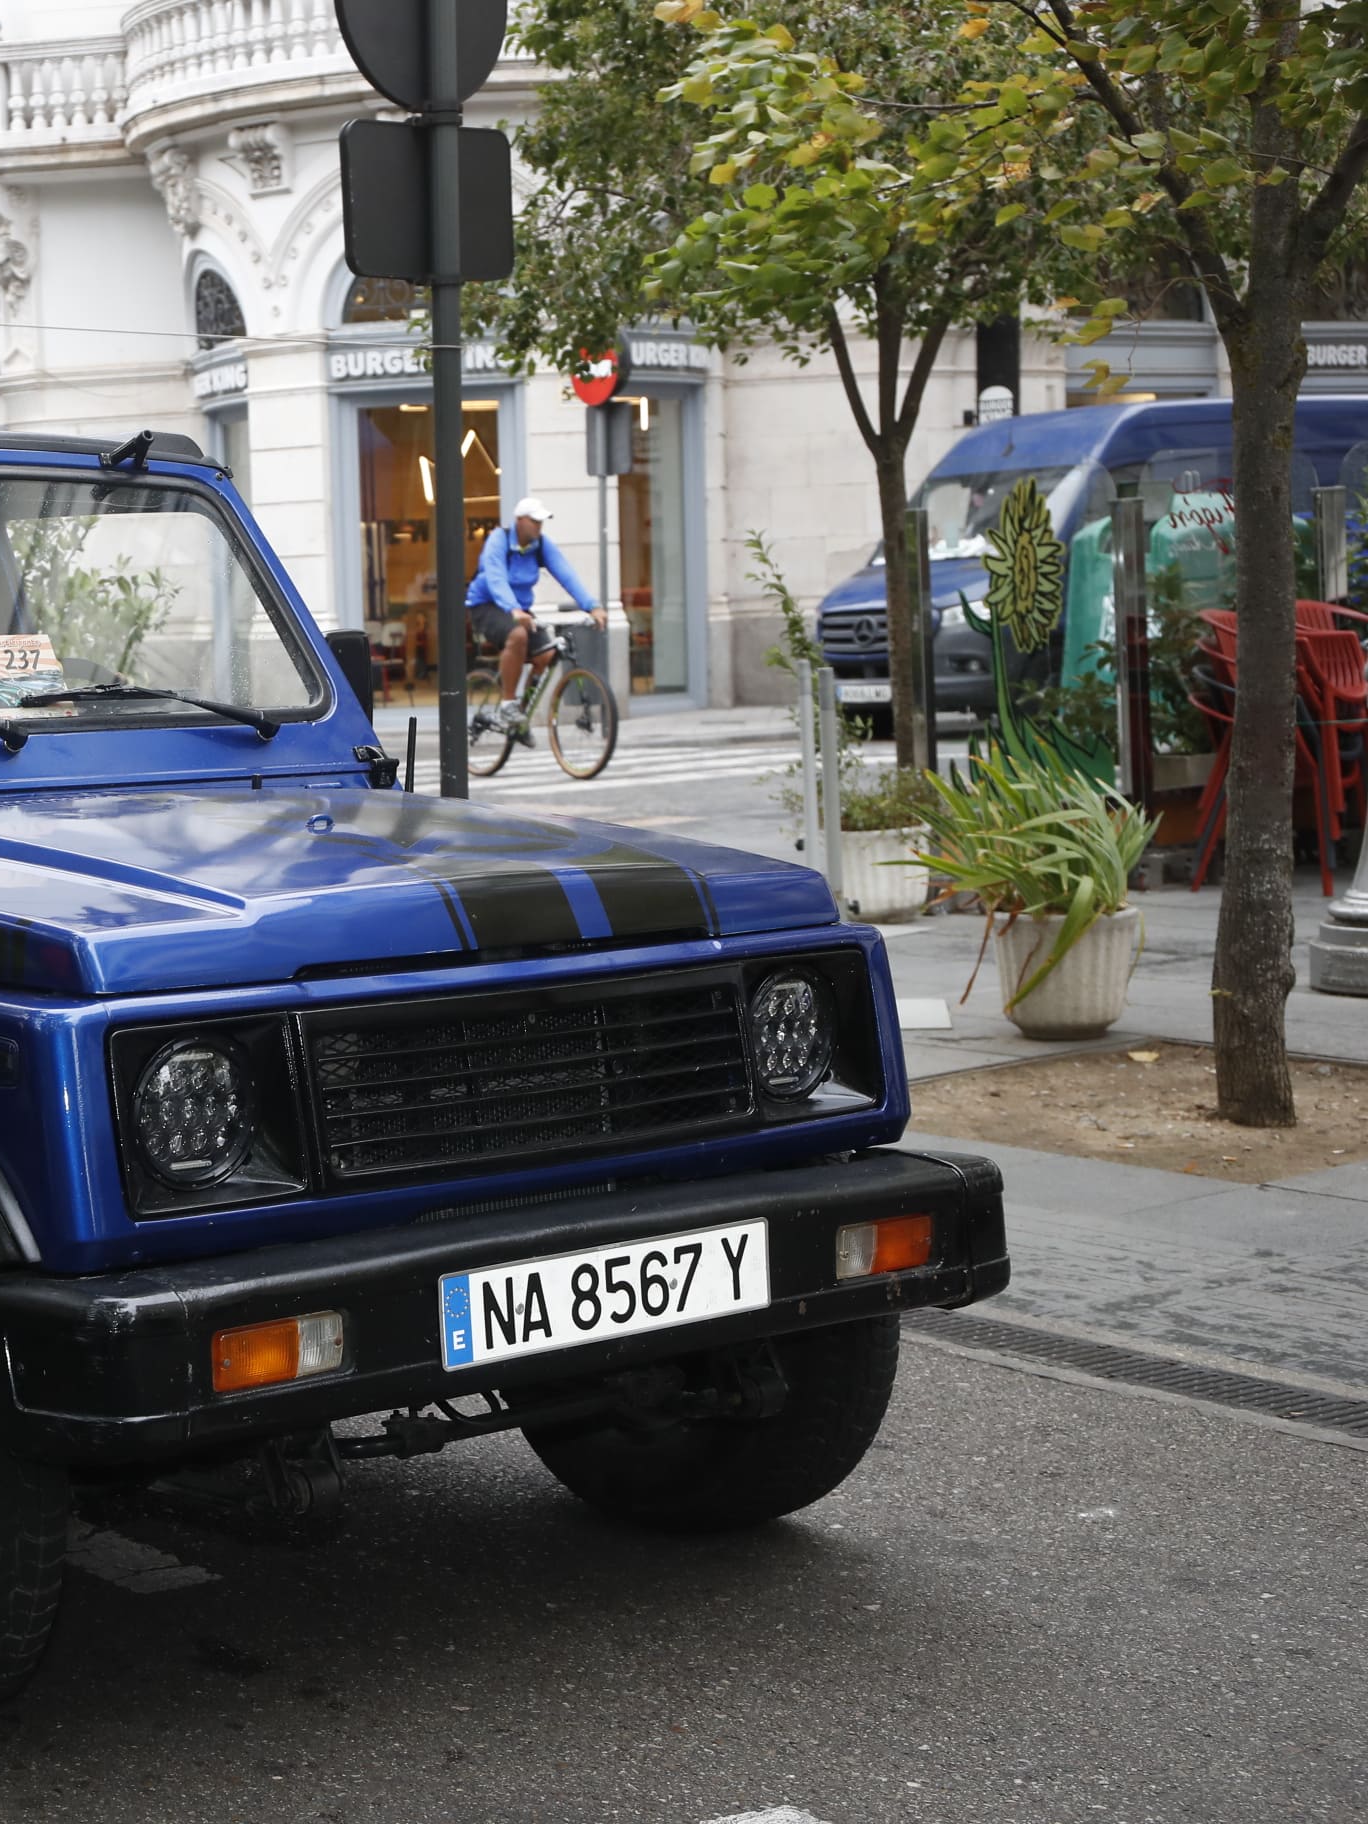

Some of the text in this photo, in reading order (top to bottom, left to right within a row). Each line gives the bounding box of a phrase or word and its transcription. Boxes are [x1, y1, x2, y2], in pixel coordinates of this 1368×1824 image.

[331, 350, 430, 378] BURGE
[631, 341, 687, 367] URGER
[1306, 344, 1368, 367] BURGER
[3, 649, 41, 670] 237
[482, 1233, 749, 1350] NA 8567 Y
[453, 1329, 466, 1351] E
